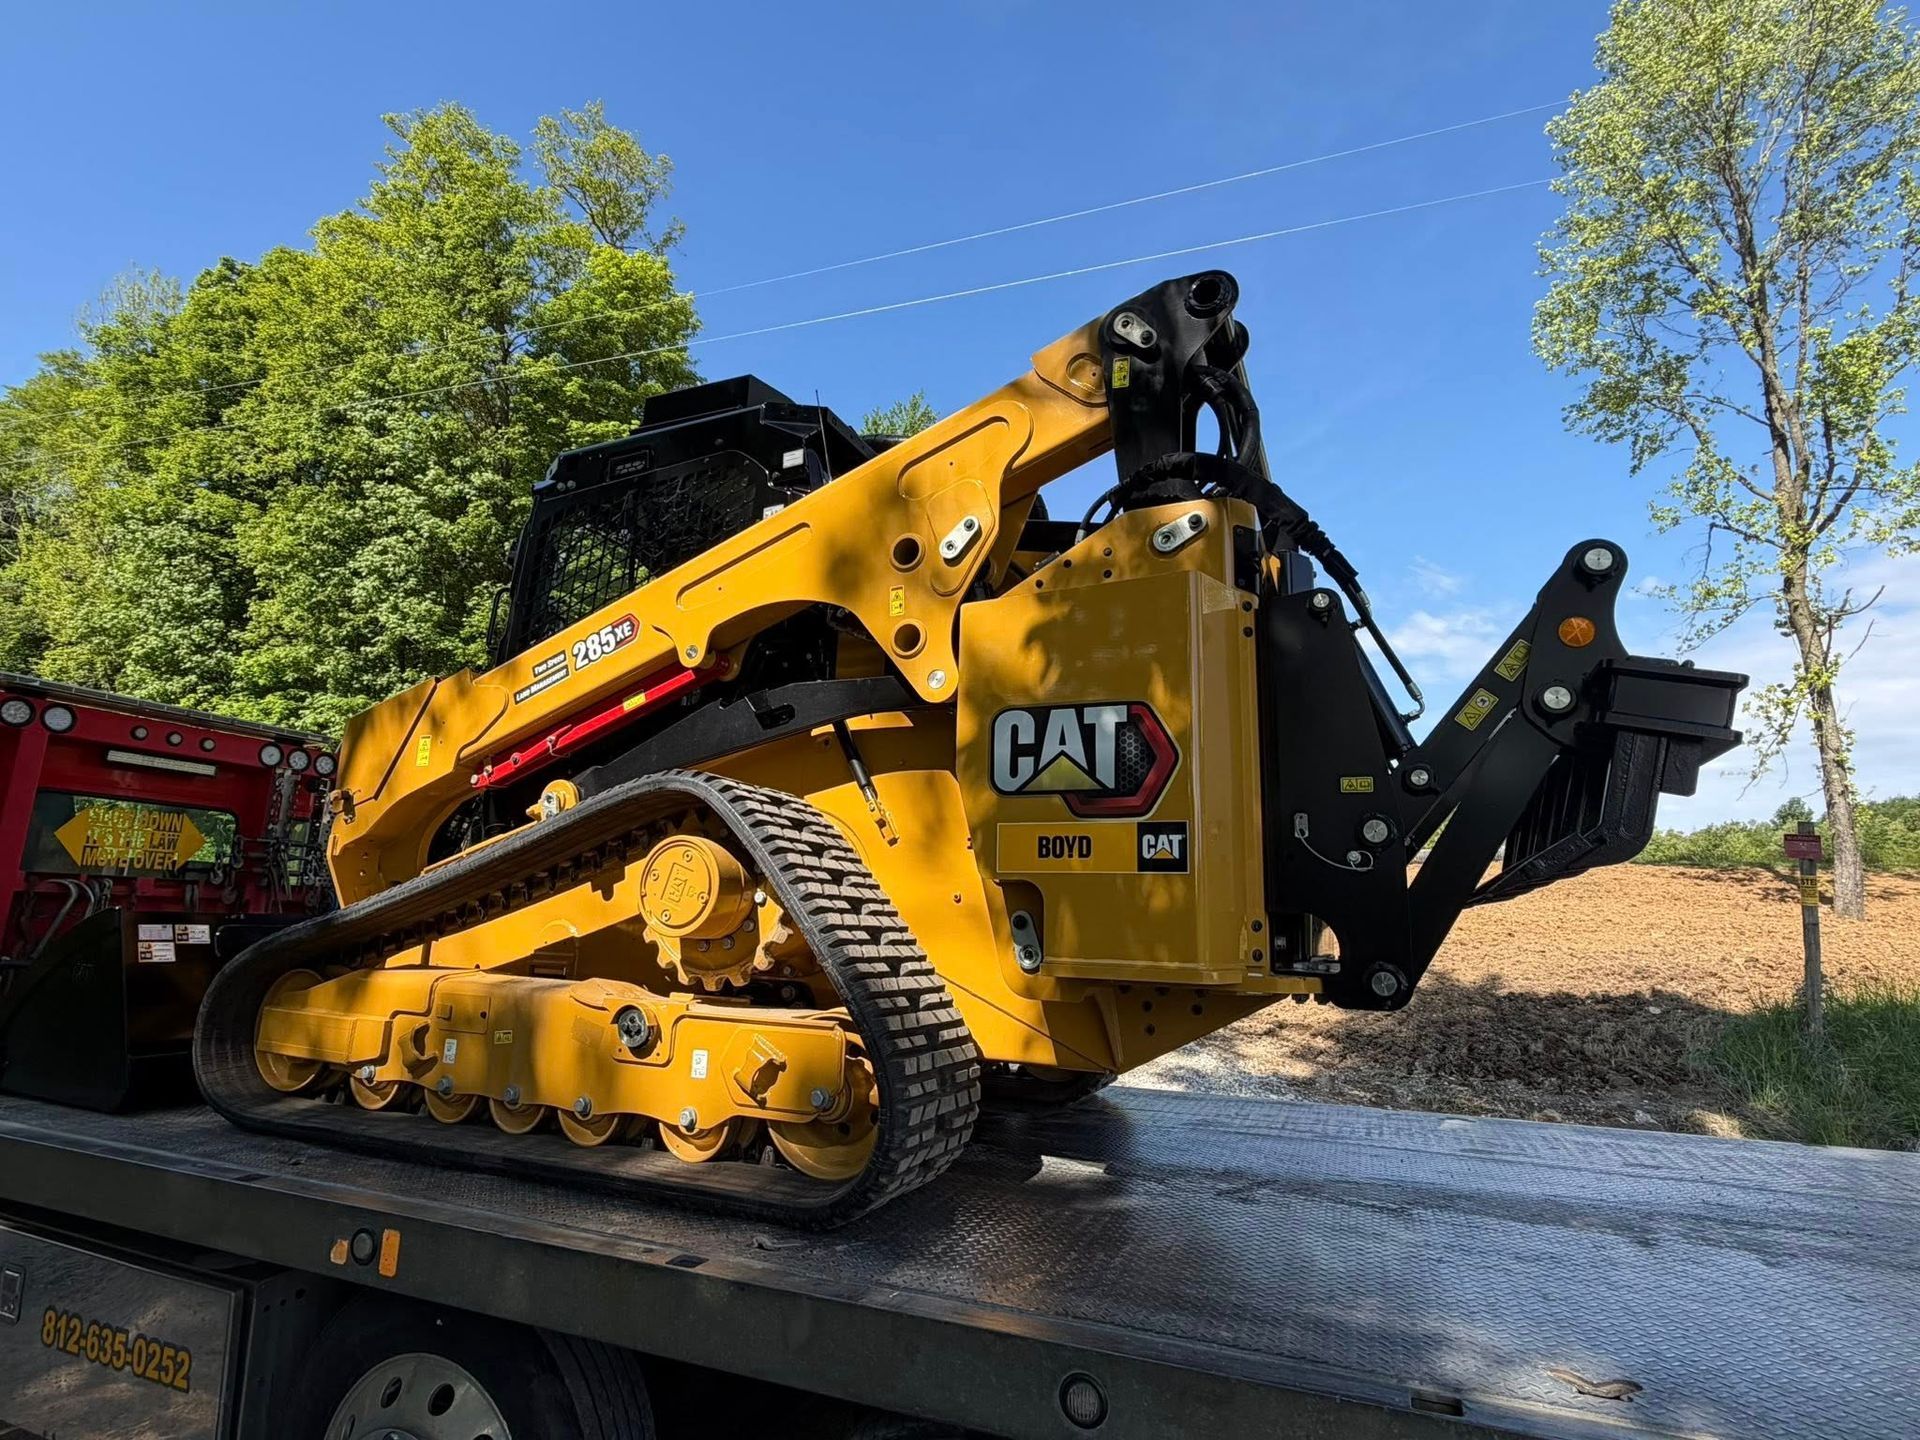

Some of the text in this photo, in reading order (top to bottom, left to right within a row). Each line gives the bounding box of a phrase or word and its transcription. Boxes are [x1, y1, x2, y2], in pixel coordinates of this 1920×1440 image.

[994, 705, 1127, 791] CAT
[149, 831, 180, 850] LAW
[1037, 836, 1092, 859] BOYD
[1142, 834, 1182, 859] CAT
[41, 1309, 191, 1391] 812-635-0252
